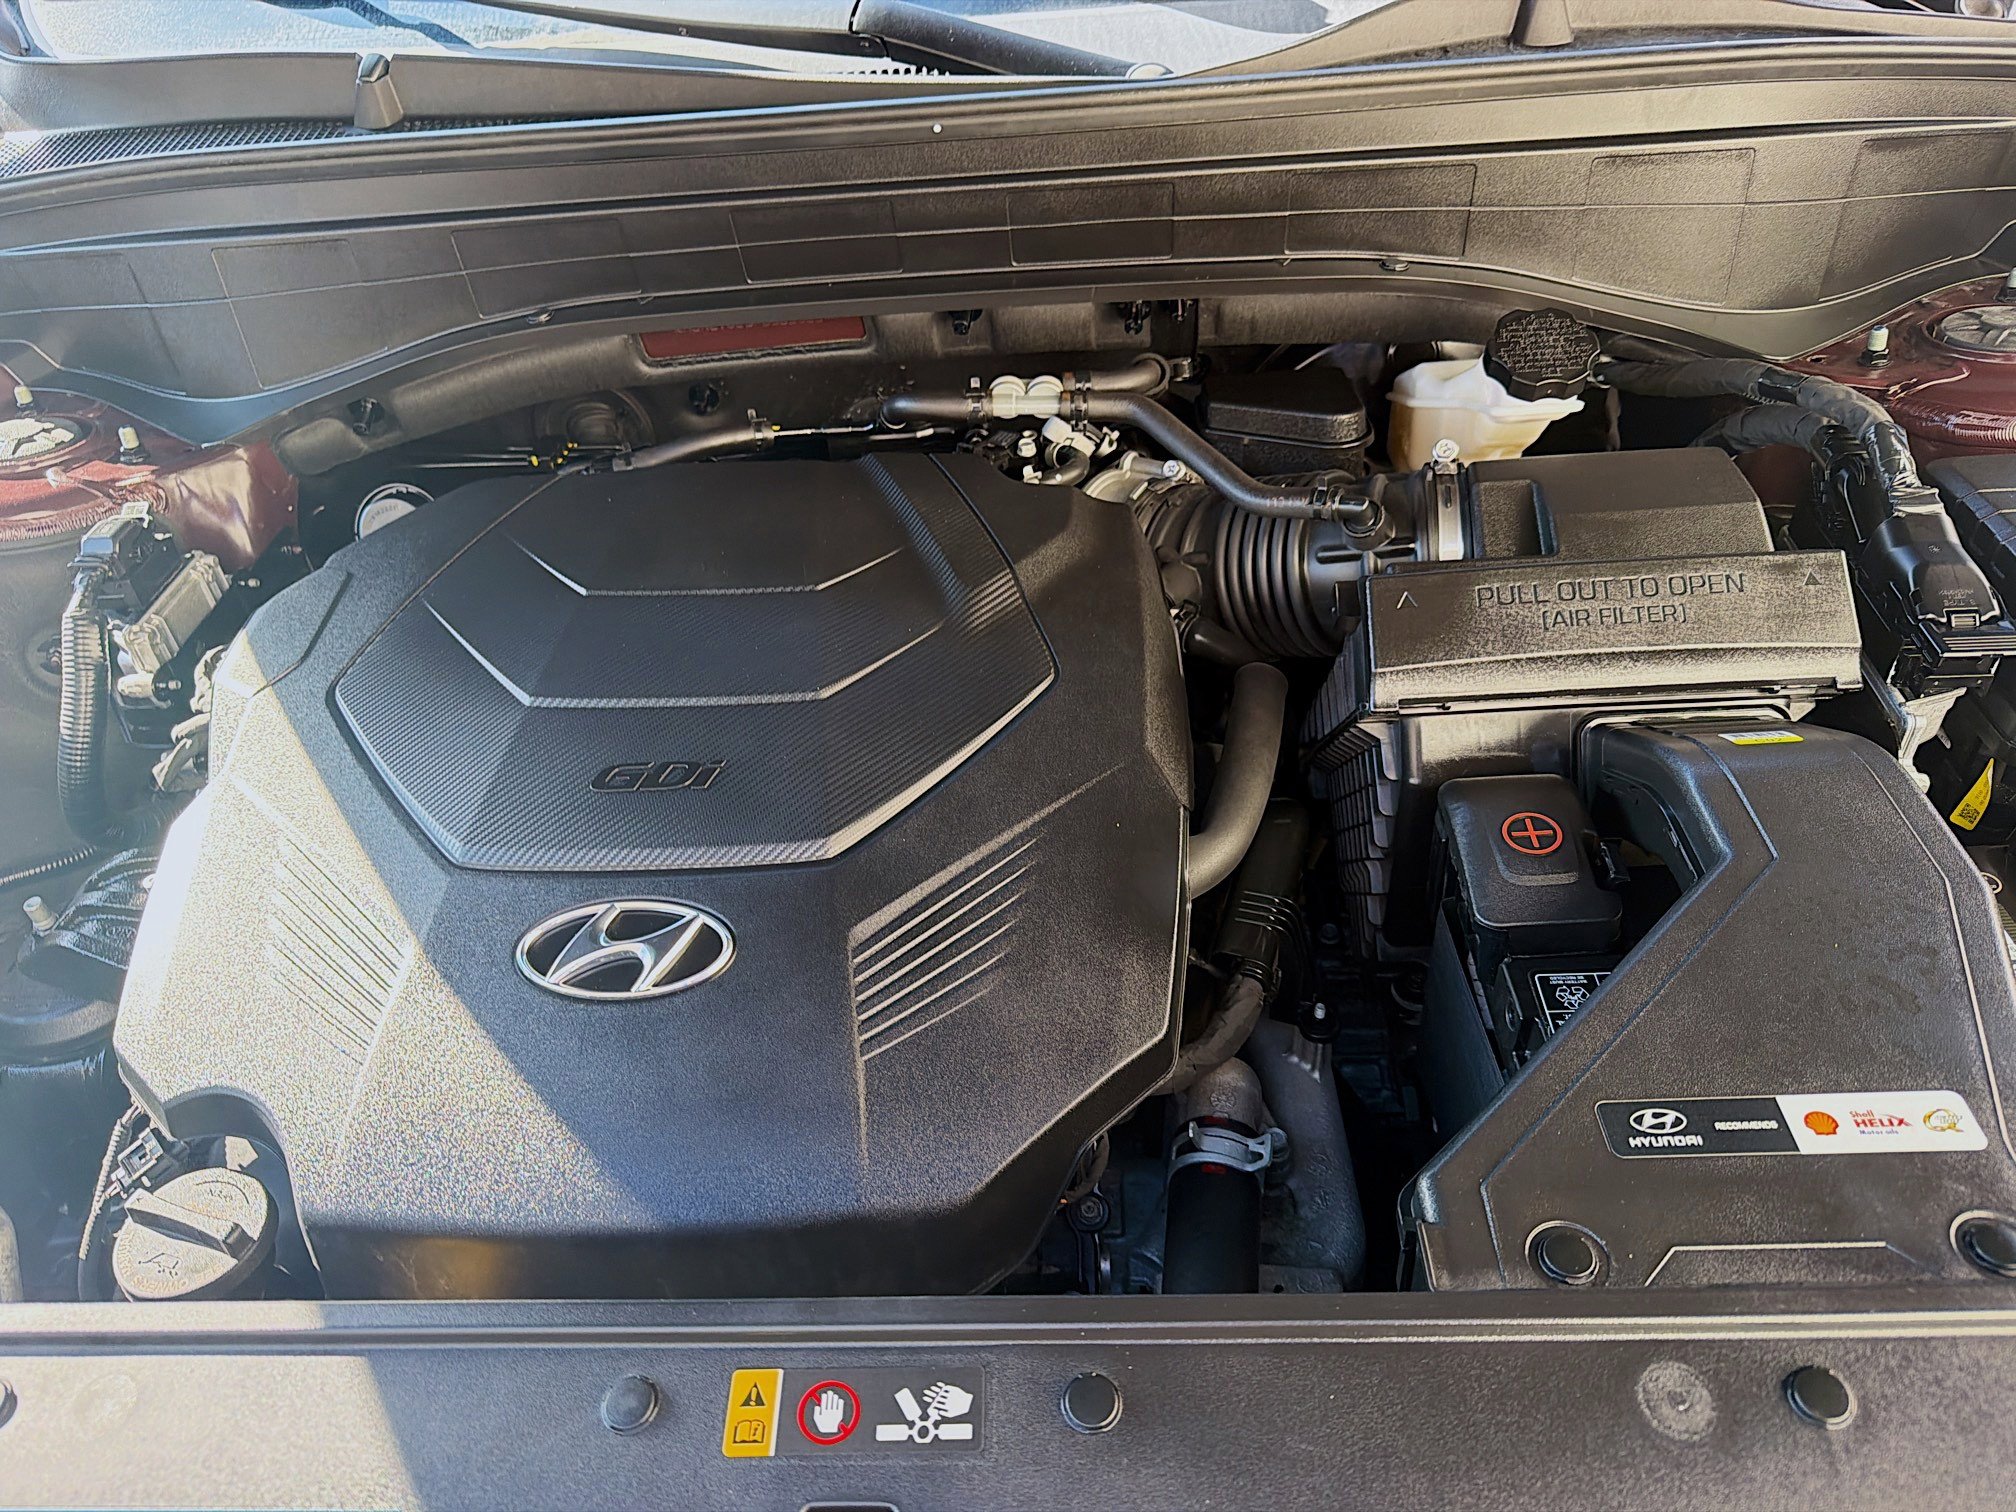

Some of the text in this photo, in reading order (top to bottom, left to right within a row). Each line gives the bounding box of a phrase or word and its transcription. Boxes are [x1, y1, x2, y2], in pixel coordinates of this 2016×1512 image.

[1475, 571, 1744, 608] PULL OUT TO OPEN
[1849, 1109, 1875, 1118] Shell
[1852, 1117, 1908, 1128] HELIX
[1628, 1120, 1779, 1148] HYUNDAI RECOMMENDS
